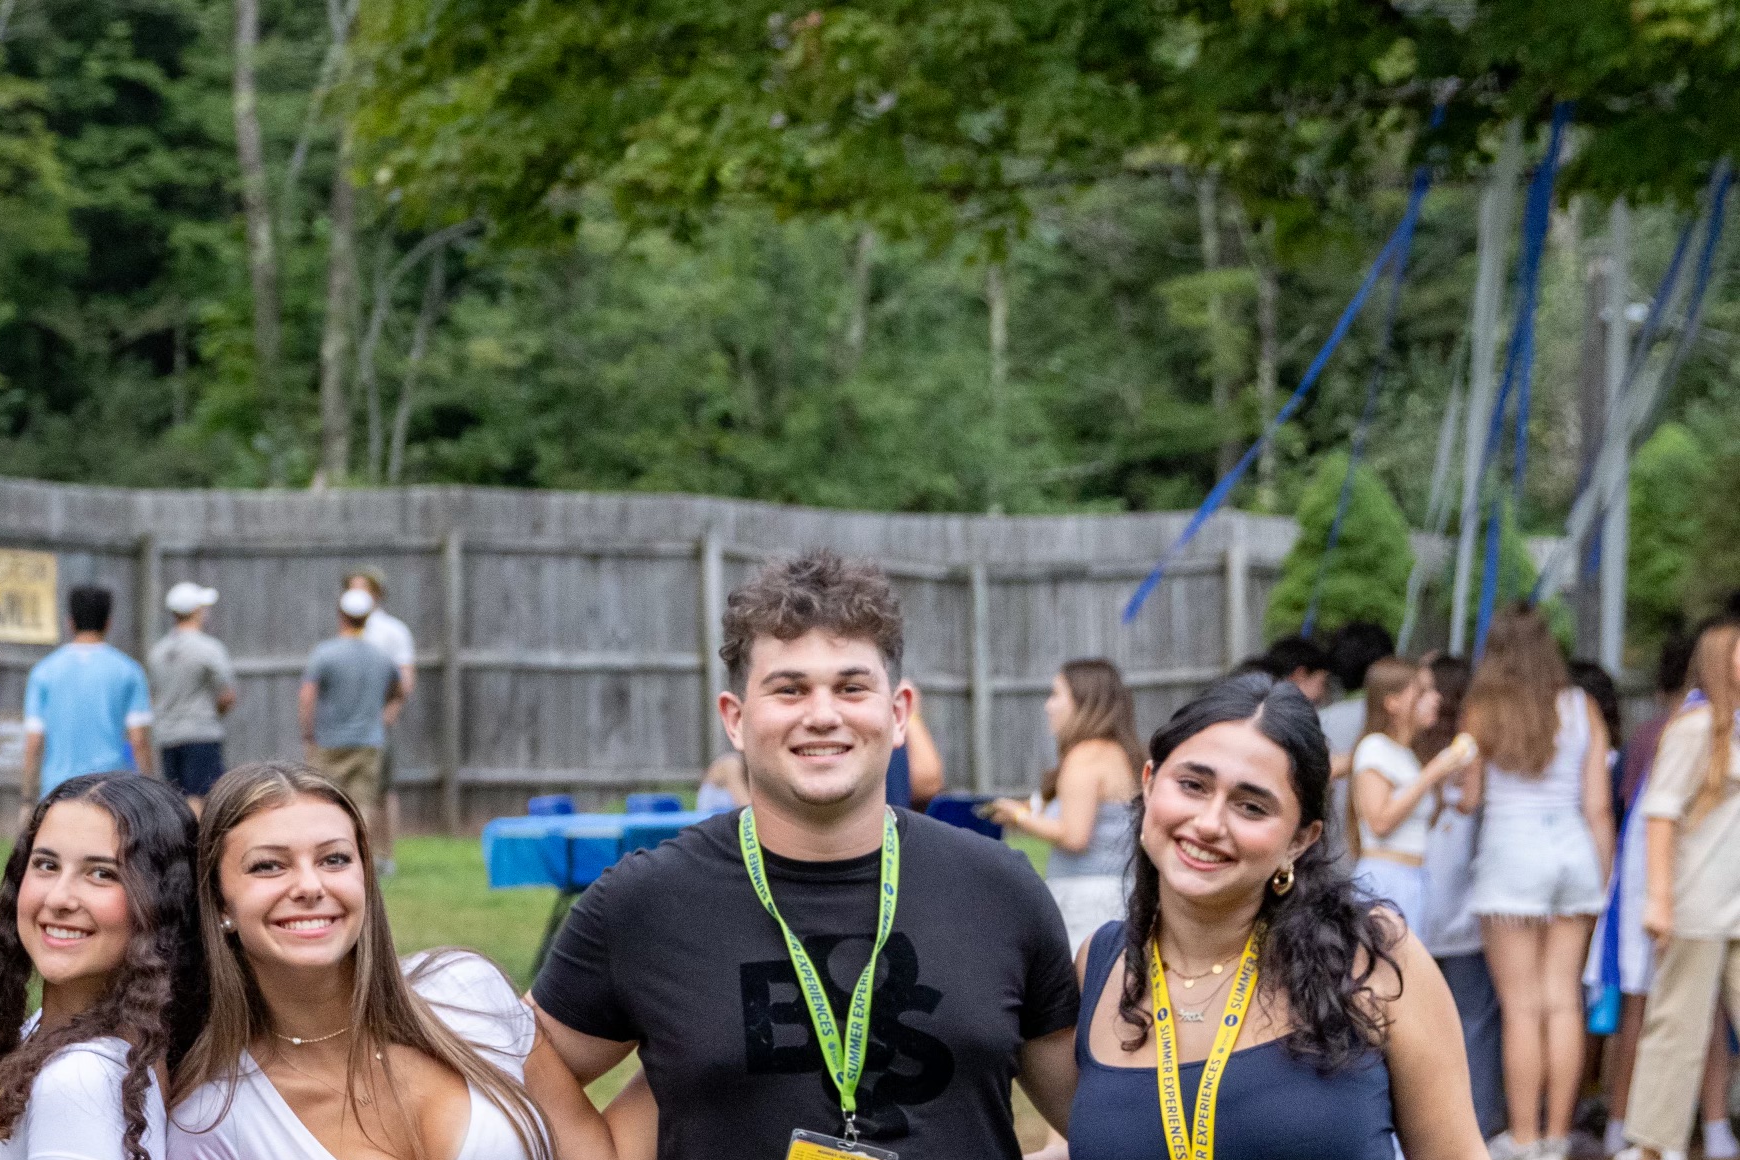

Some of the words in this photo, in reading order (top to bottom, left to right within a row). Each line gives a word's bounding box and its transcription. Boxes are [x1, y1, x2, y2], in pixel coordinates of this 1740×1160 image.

[743, 812, 756, 850] EXPERI
[748, 852, 768, 900] SUMMER
[795, 953, 834, 1036] EXPERIENCES
[853, 962, 872, 1018] EXPERIE
[1231, 956, 1258, 1010] SUMMER
[847, 1021, 863, 1082] SUMMER
[1160, 1025, 1173, 1073] SUMMER
[1164, 1077, 1188, 1160] EXPERIENCES
[1196, 1059, 1221, 1146] EXPERIENCES
